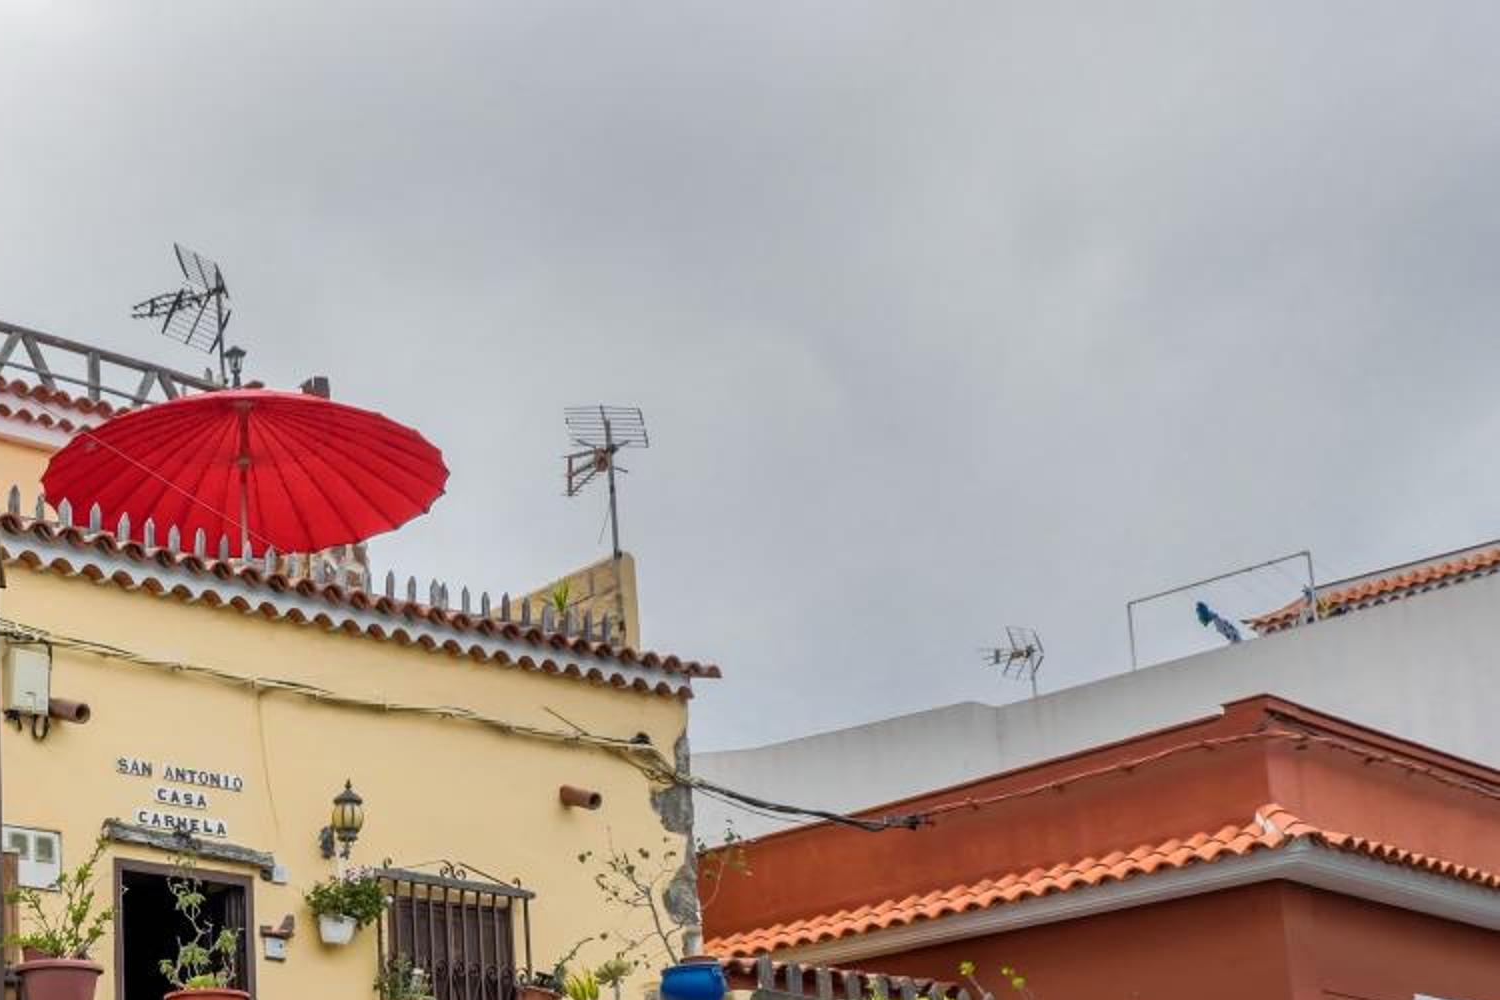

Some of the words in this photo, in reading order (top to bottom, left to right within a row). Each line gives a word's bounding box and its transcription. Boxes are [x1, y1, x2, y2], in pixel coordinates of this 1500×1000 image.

[117, 758, 153, 777] SAN
[164, 767, 243, 792] ANTONIO
[157, 788, 207, 807] CASA
[138, 811, 227, 835] CARMELA
